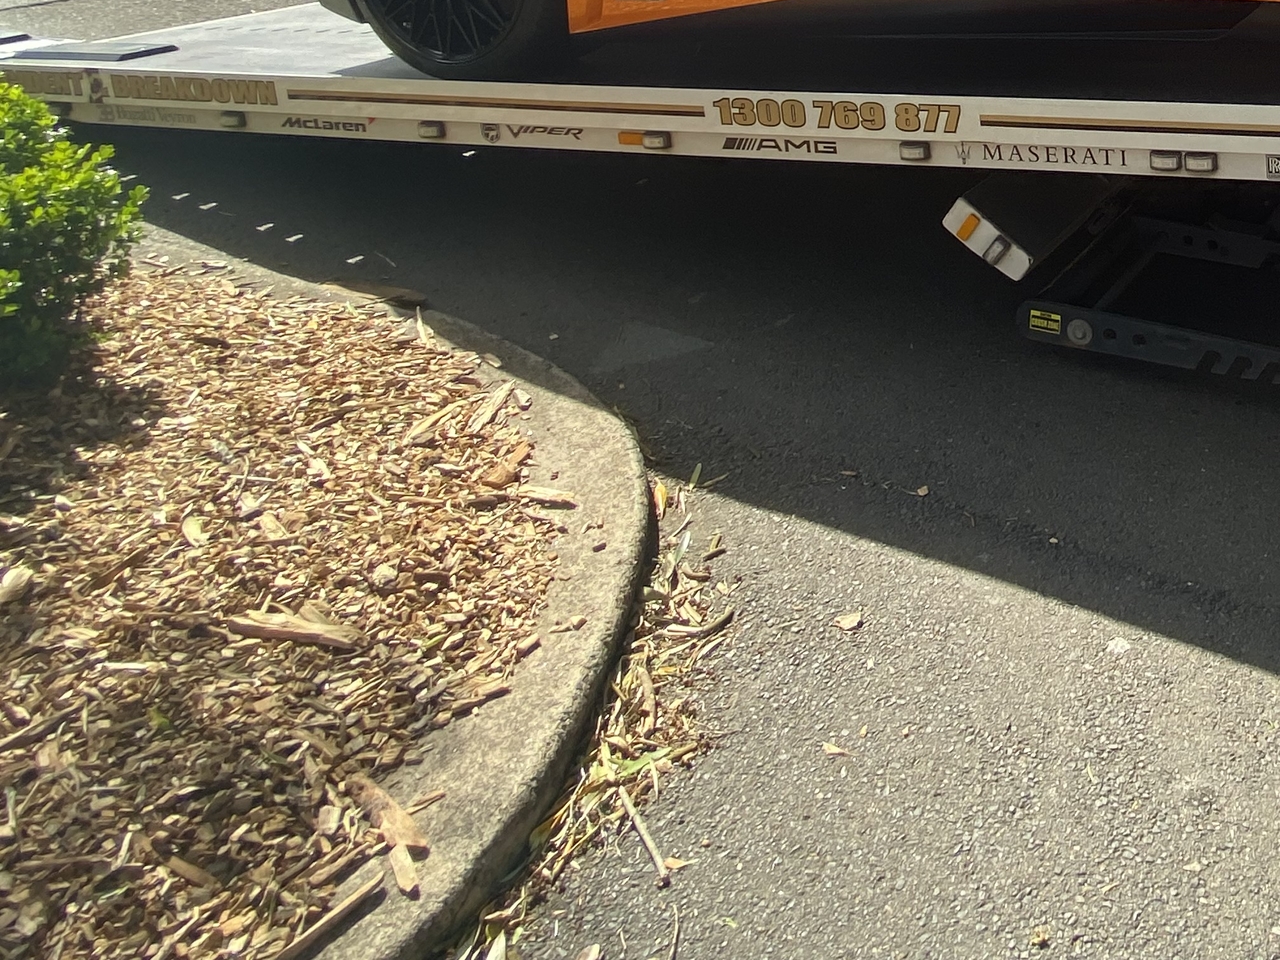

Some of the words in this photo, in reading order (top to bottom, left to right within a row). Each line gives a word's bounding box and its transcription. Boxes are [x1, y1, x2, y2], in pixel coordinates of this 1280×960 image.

[111, 74, 278, 106] BREAKDOWN
[281, 117, 367, 132] McLaren
[713, 98, 807, 128] 1300
[812, 100, 886, 130] 769
[894, 103, 961, 133] 877
[506, 124, 584, 140] VIPER
[756, 138, 838, 154] AMG
[982, 144, 1128, 167] MASERATI
